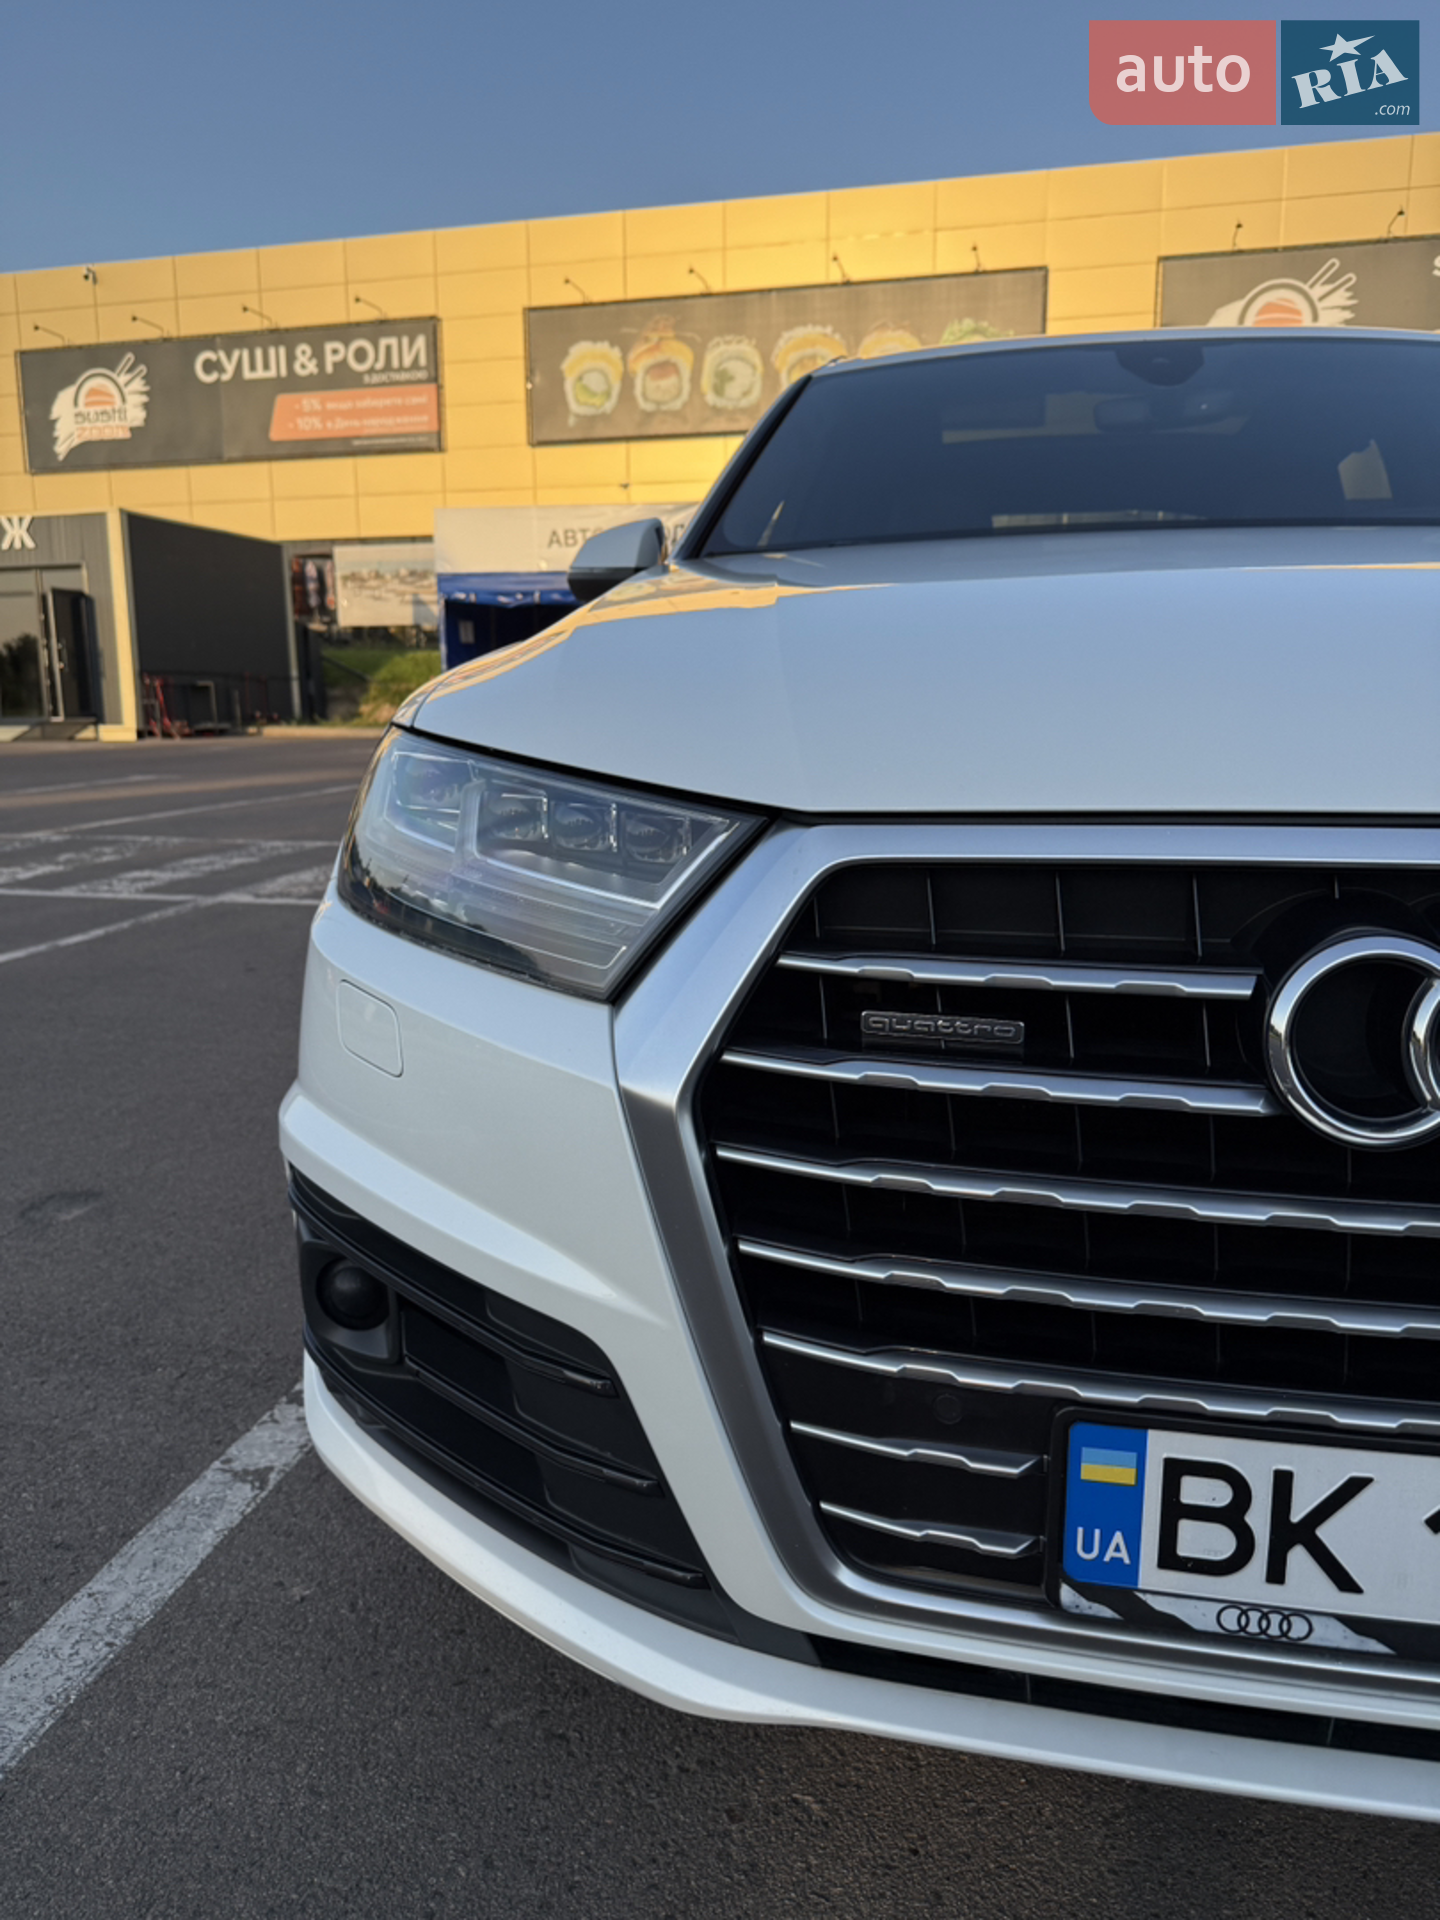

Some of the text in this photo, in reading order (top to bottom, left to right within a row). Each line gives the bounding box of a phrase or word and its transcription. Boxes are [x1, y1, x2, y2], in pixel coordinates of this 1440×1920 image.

[194, 333, 428, 385] СУШІ & РОЛИ
[0, 515, 36, 551] Ж
[868, 1016, 1017, 1038] quattro
[1076, 1526, 1131, 1565] UA
